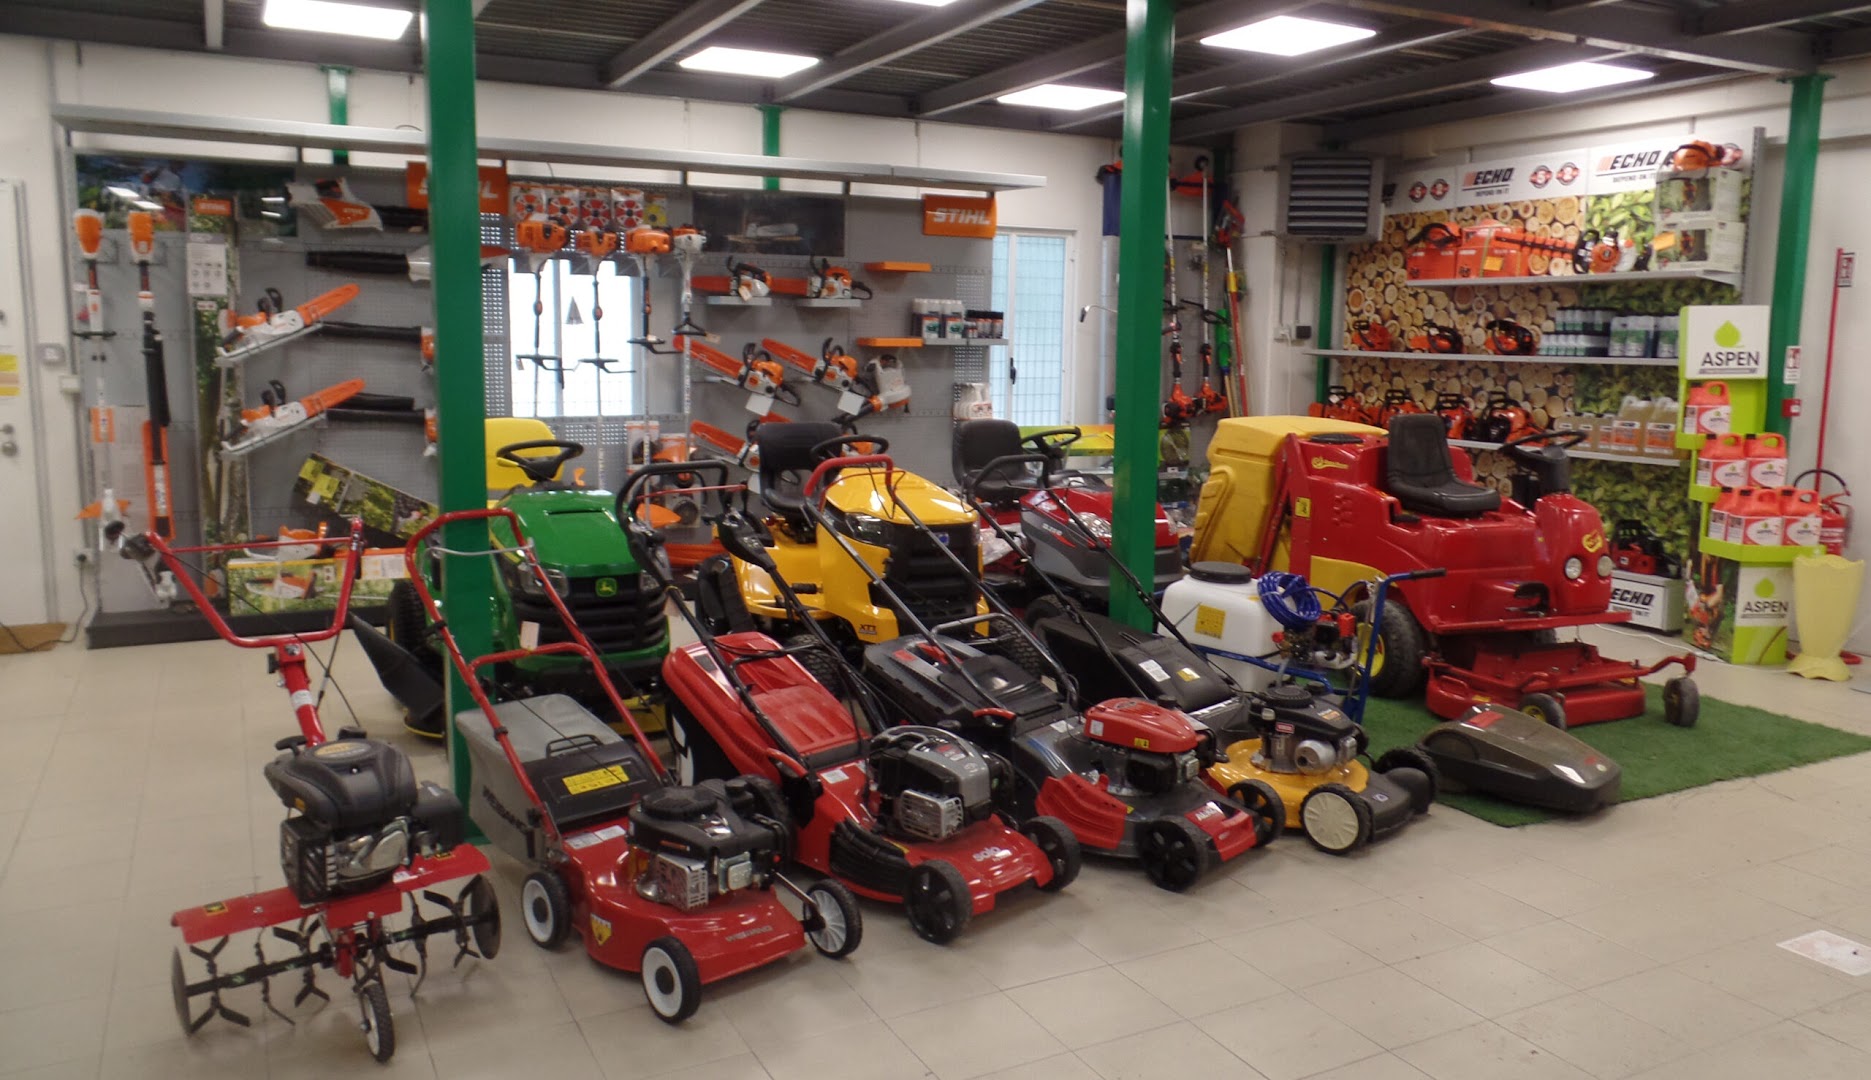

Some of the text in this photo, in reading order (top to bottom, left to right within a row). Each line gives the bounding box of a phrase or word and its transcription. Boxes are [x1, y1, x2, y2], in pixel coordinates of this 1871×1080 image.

[1610, 151, 1662, 170] ECHO
[1473, 167, 1515, 186] ECHO
[933, 207, 991, 225] STIHL
[1701, 351, 1760, 367] ASPEN
[1611, 588, 1655, 606] ECHO
[1743, 600, 1788, 614] ASPEN
